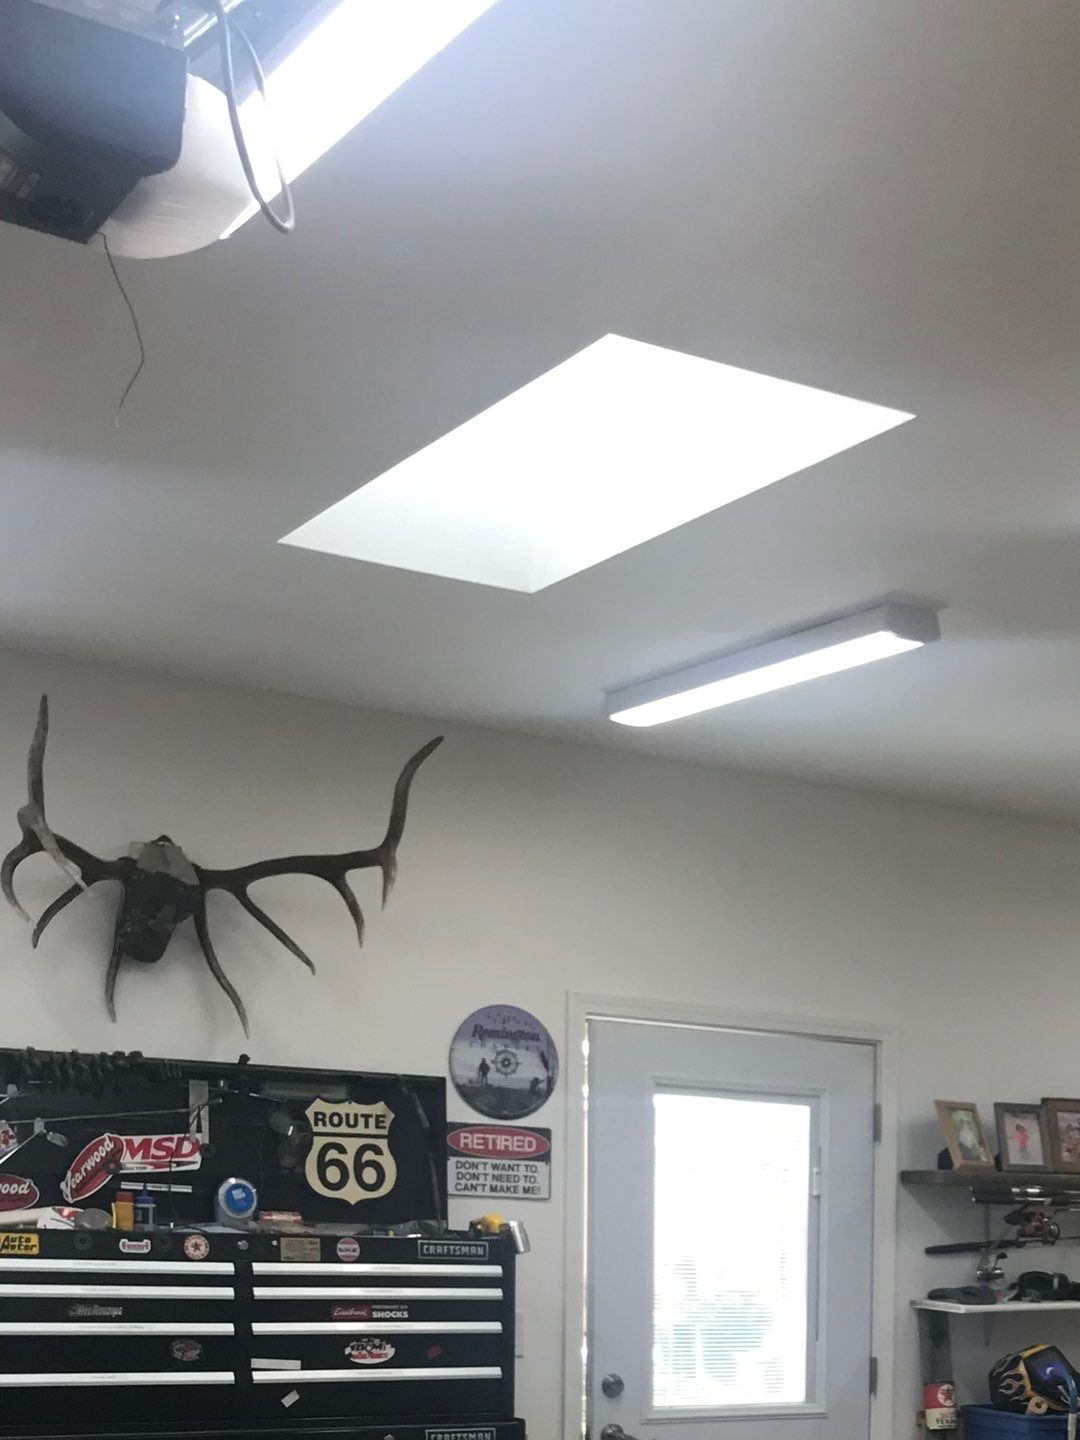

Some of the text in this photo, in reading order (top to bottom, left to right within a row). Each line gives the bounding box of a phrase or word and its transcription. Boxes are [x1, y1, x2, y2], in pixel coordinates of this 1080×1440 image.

[314, 1111, 387, 1129] ROUTE
[460, 1133, 537, 1152] RETIRED
[124, 1137, 200, 1161] MSD
[317, 1142, 386, 1192] 66
[455, 1161, 489, 1170] DON'T
[491, 1163, 521, 1172] WANT
[456, 1172, 489, 1182] DON'T
[492, 1174, 520, 1183] NEED
[455, 1183, 541, 1195] CAN'T MAKE ME!
[3, 1235, 31, 1244] Auto
[423, 1244, 484, 1255] CRAFTSMAN
[371, 1311, 409, 1319] SHOCKS
